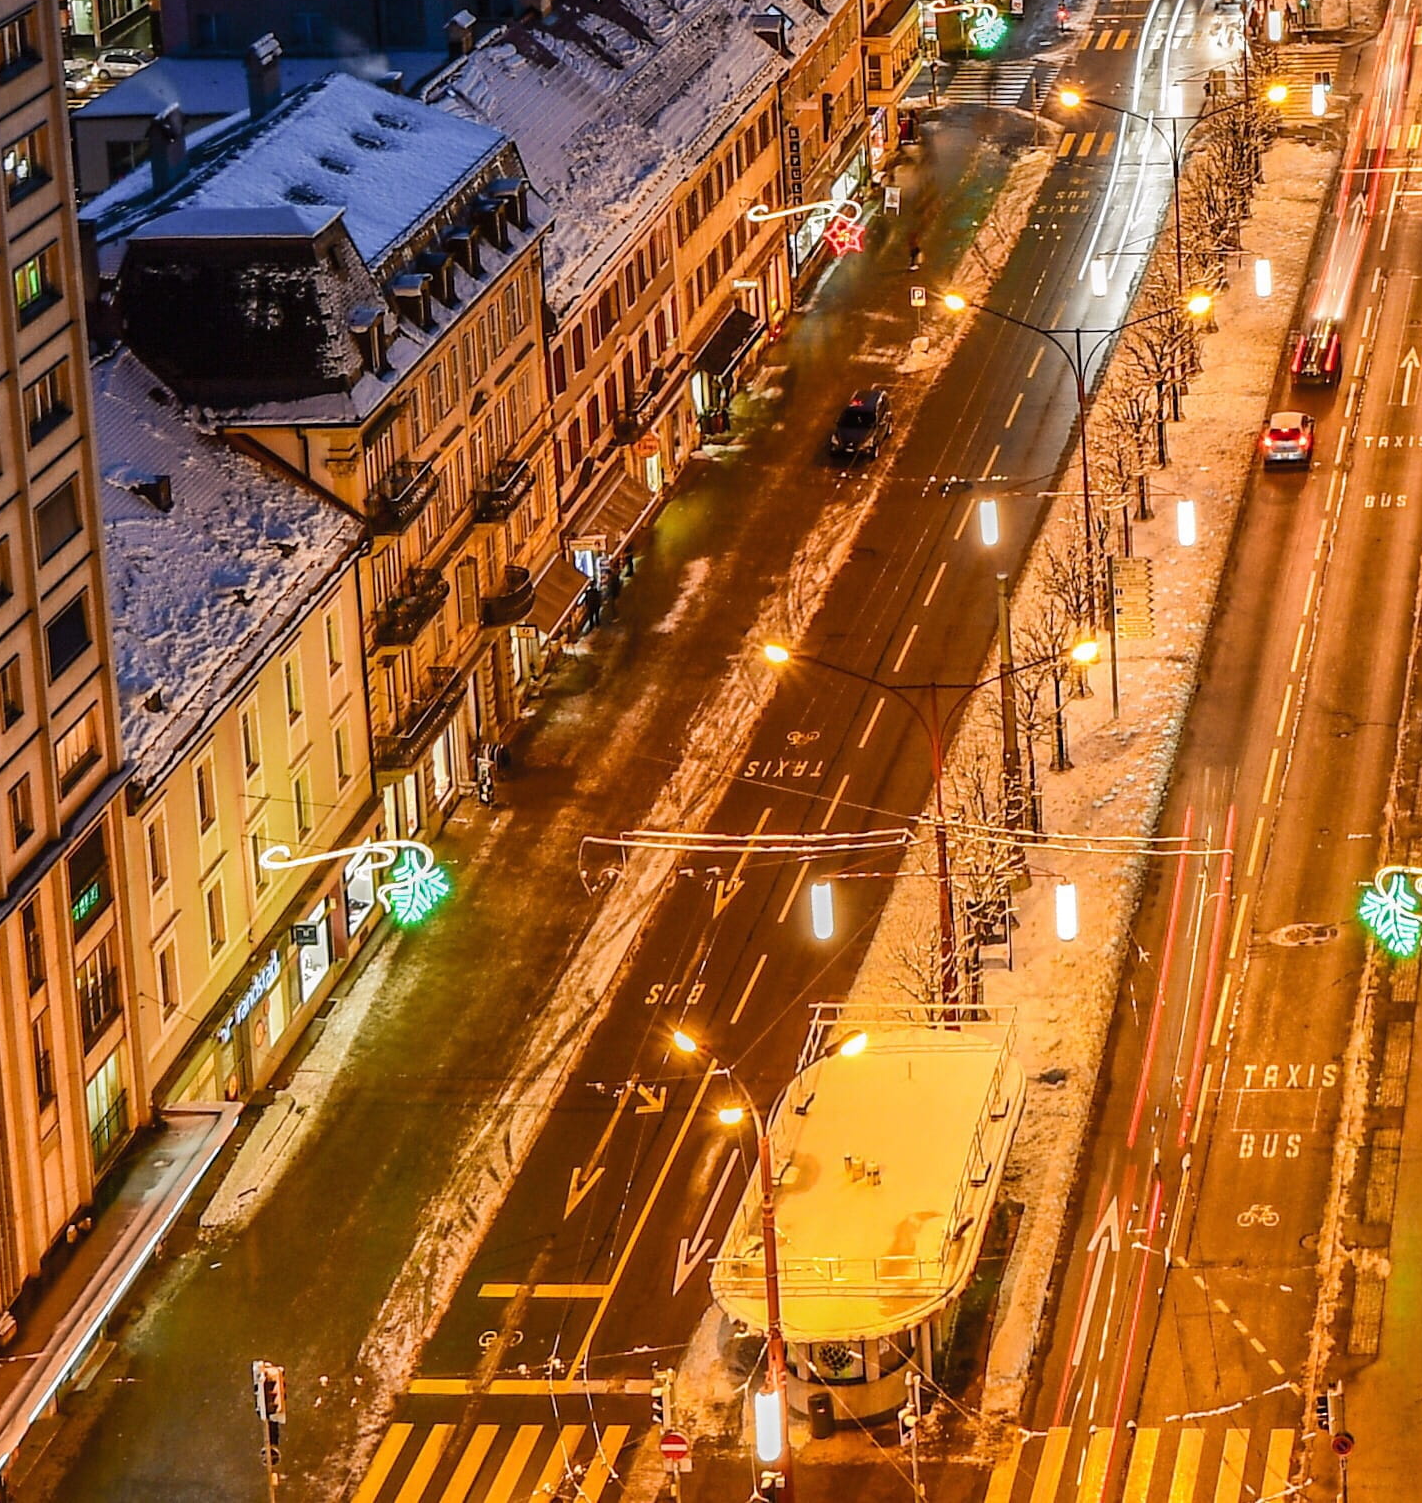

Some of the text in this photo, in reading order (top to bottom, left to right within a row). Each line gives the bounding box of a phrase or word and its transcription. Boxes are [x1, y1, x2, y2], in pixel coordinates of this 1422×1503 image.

[1364, 495, 1409, 509] BUS
[744, 759, 824, 778] TAXIS
[644, 982, 707, 1005] BUS
[1243, 1063, 1340, 1088] TAXIS
[1239, 1133, 1302, 1159] BUS
